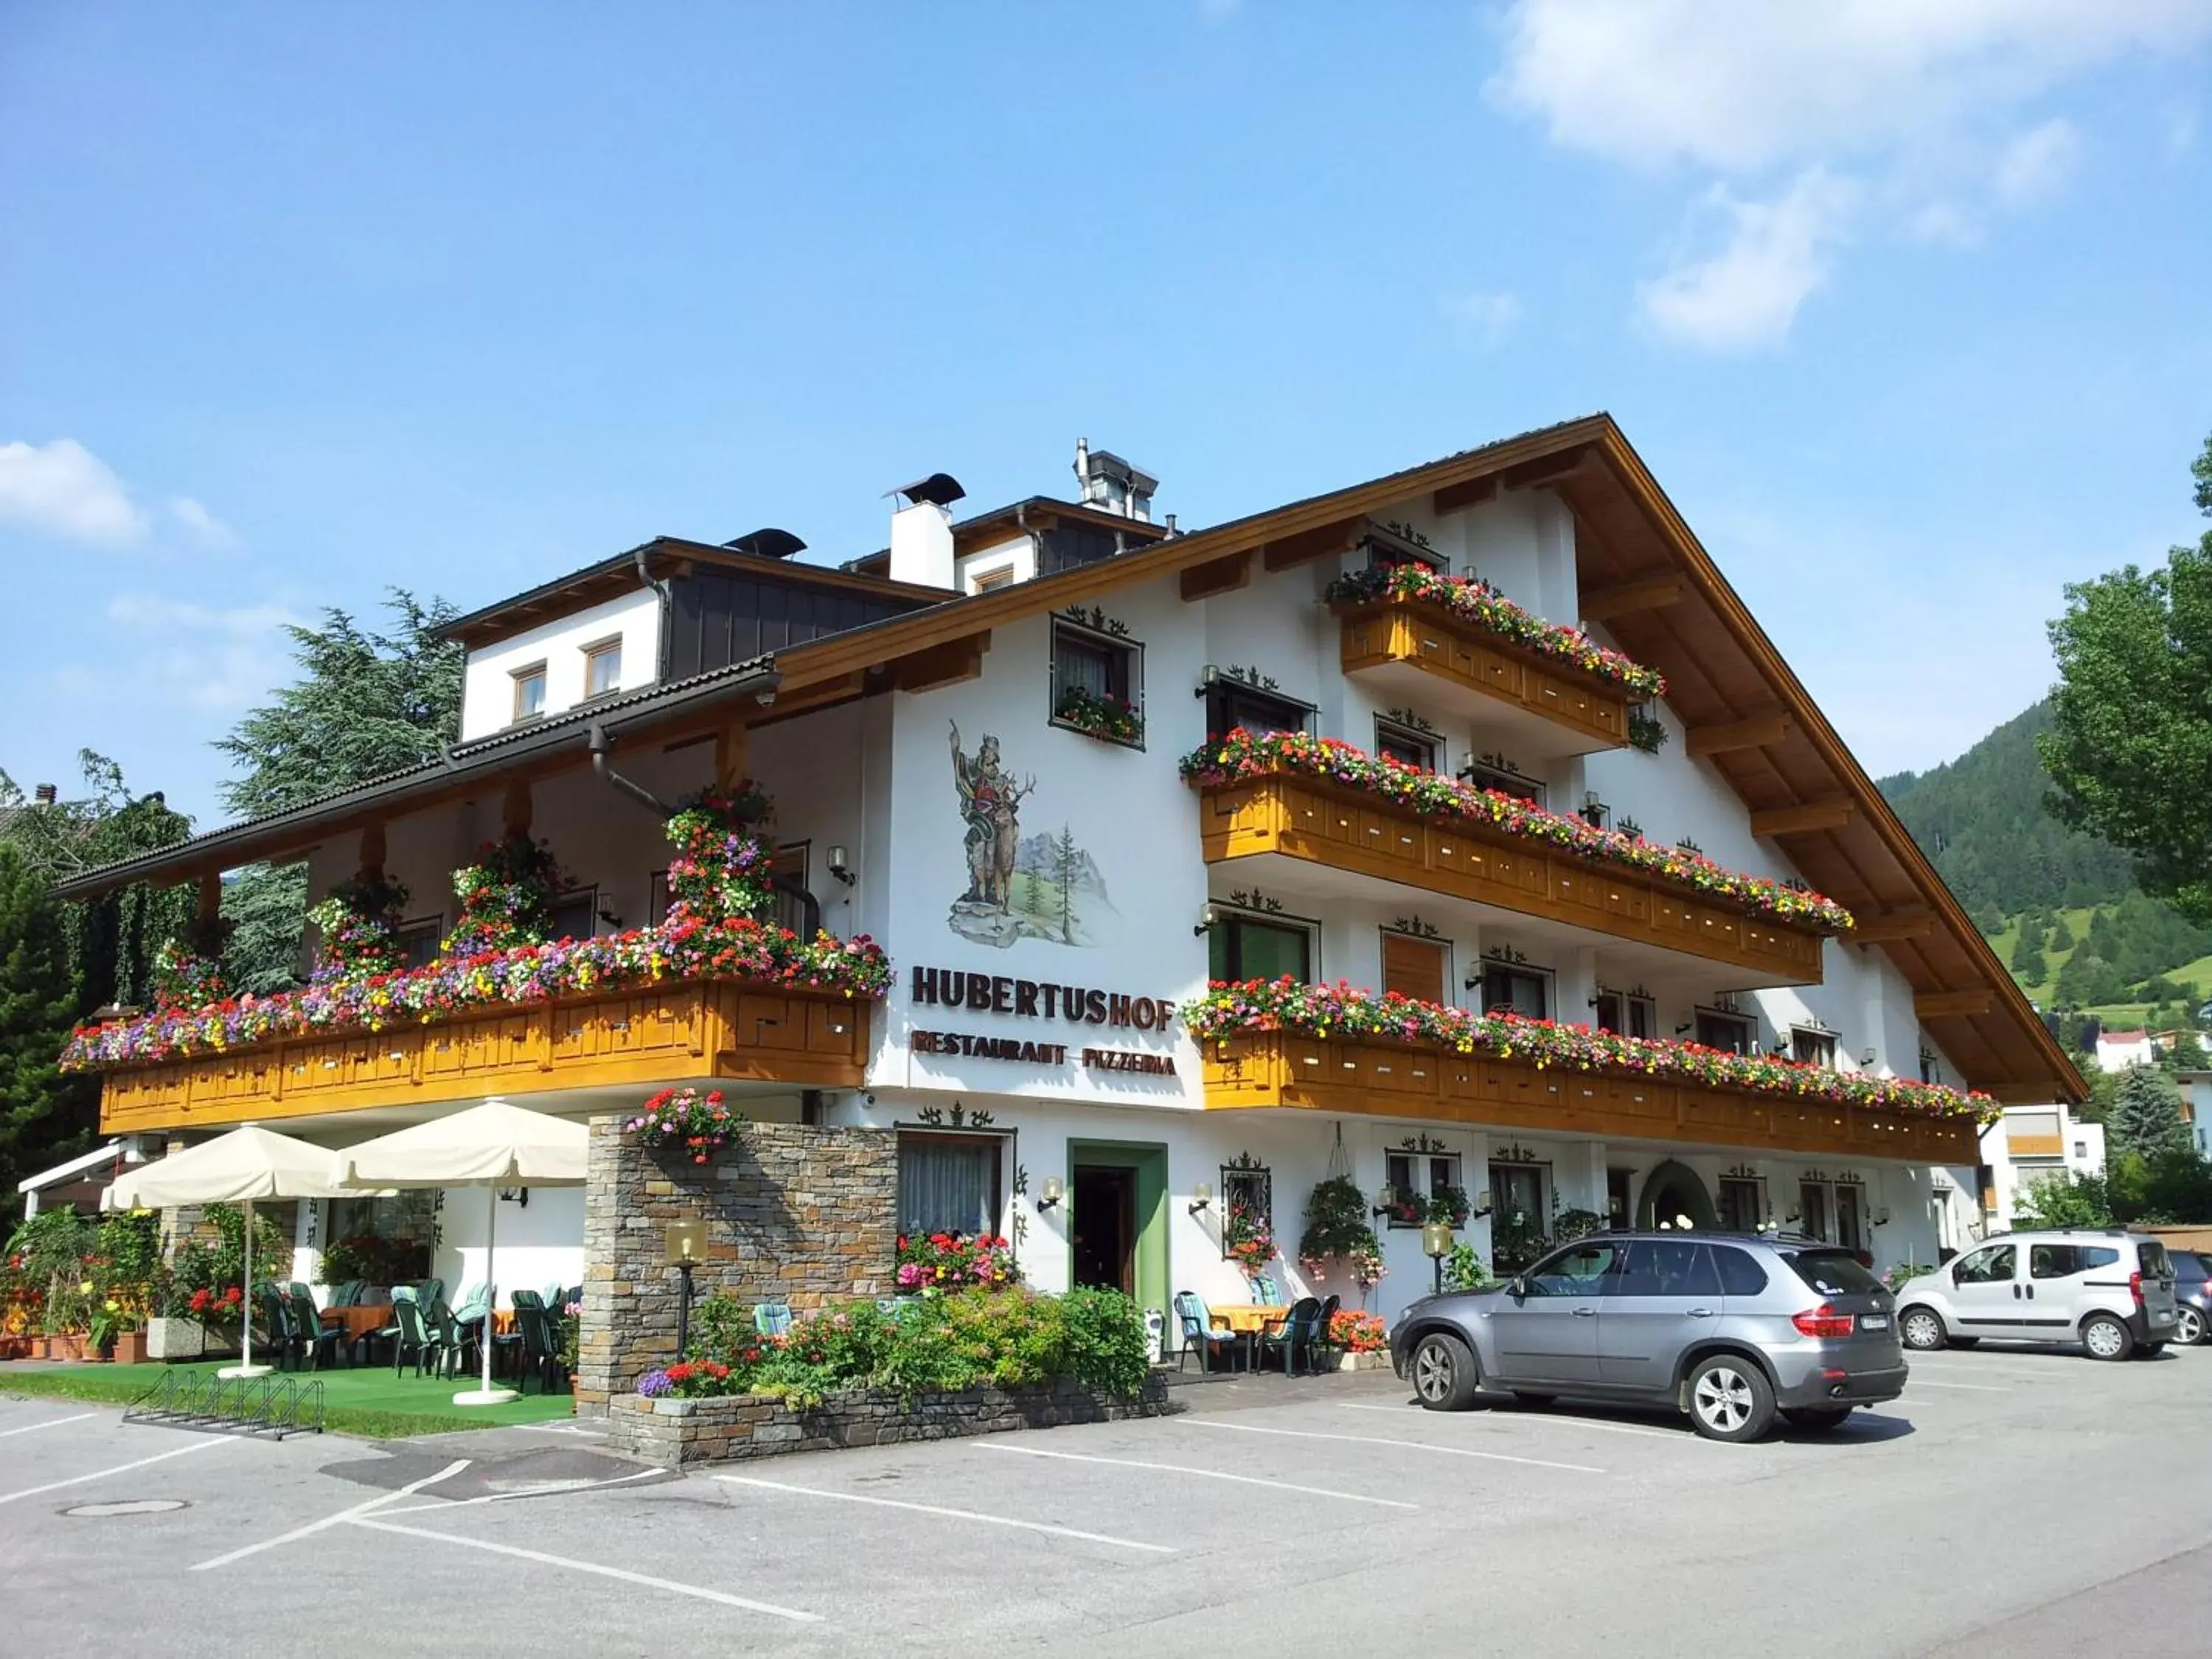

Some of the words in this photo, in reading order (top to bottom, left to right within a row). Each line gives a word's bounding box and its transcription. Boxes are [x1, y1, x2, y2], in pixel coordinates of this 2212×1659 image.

[912, 966, 1176, 1032] HUBERTUSHOF
[911, 1030, 1068, 1065] RESTAURANT
[1082, 1048, 1177, 1076] PIZZERIA
